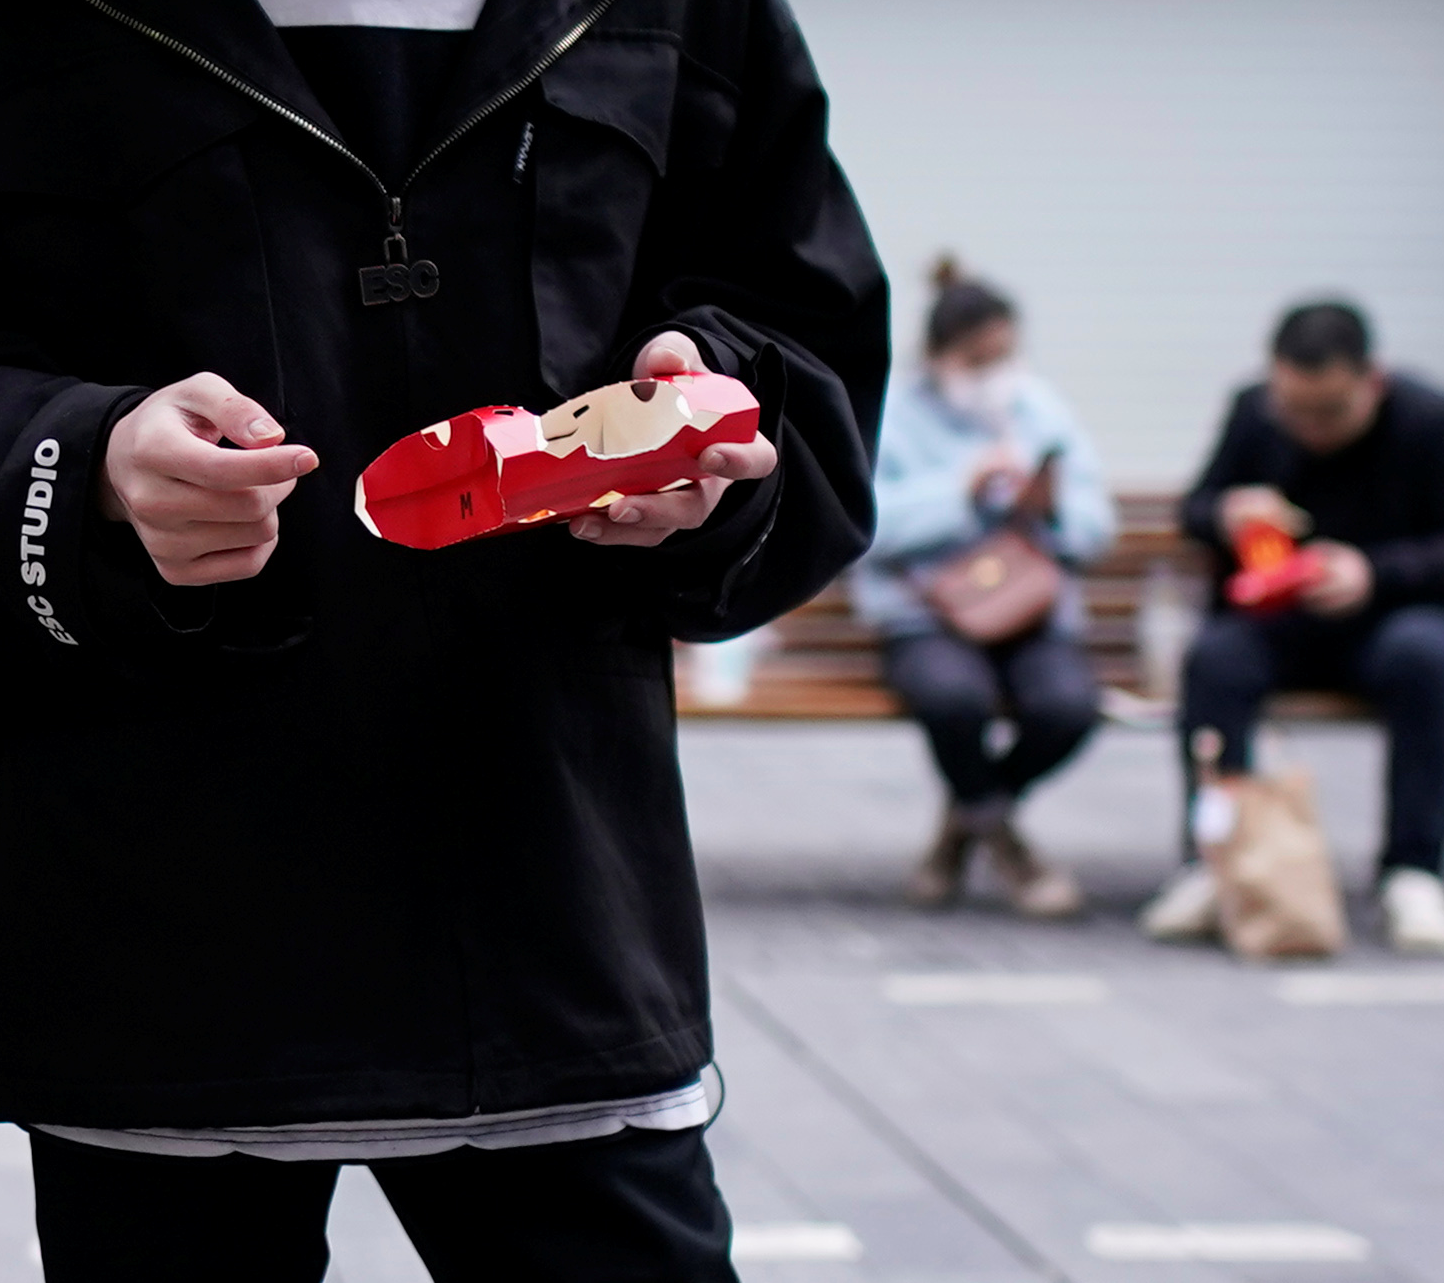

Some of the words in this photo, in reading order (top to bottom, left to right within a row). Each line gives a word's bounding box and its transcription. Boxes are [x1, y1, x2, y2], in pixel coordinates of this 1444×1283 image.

[359, 259, 440, 306] ESC
[20, 438, 60, 586] STUDIO
[26, 595, 79, 646] ESC
